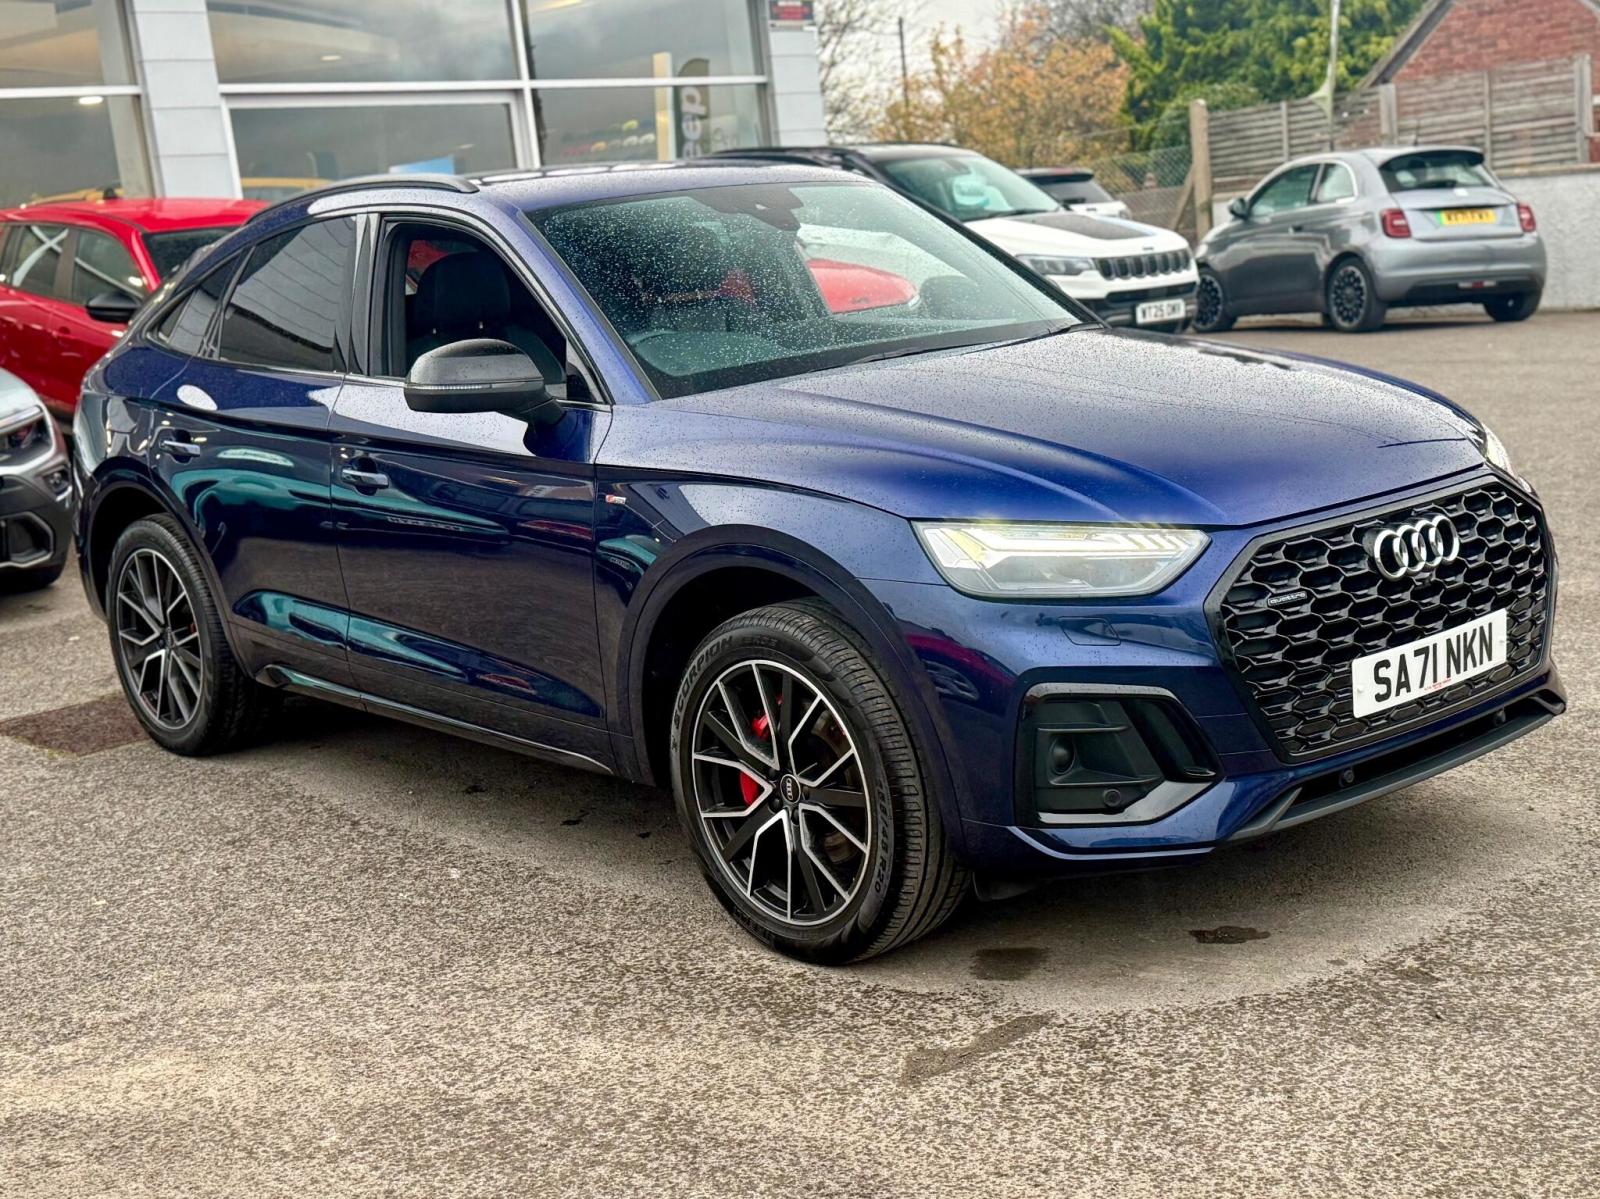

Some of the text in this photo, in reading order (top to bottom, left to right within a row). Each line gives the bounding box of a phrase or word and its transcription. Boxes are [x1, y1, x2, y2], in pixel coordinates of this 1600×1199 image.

[680, 86, 707, 159] eep
[673, 635, 733, 730] SCORPION
[1373, 622, 1493, 703] SA71 NKN
